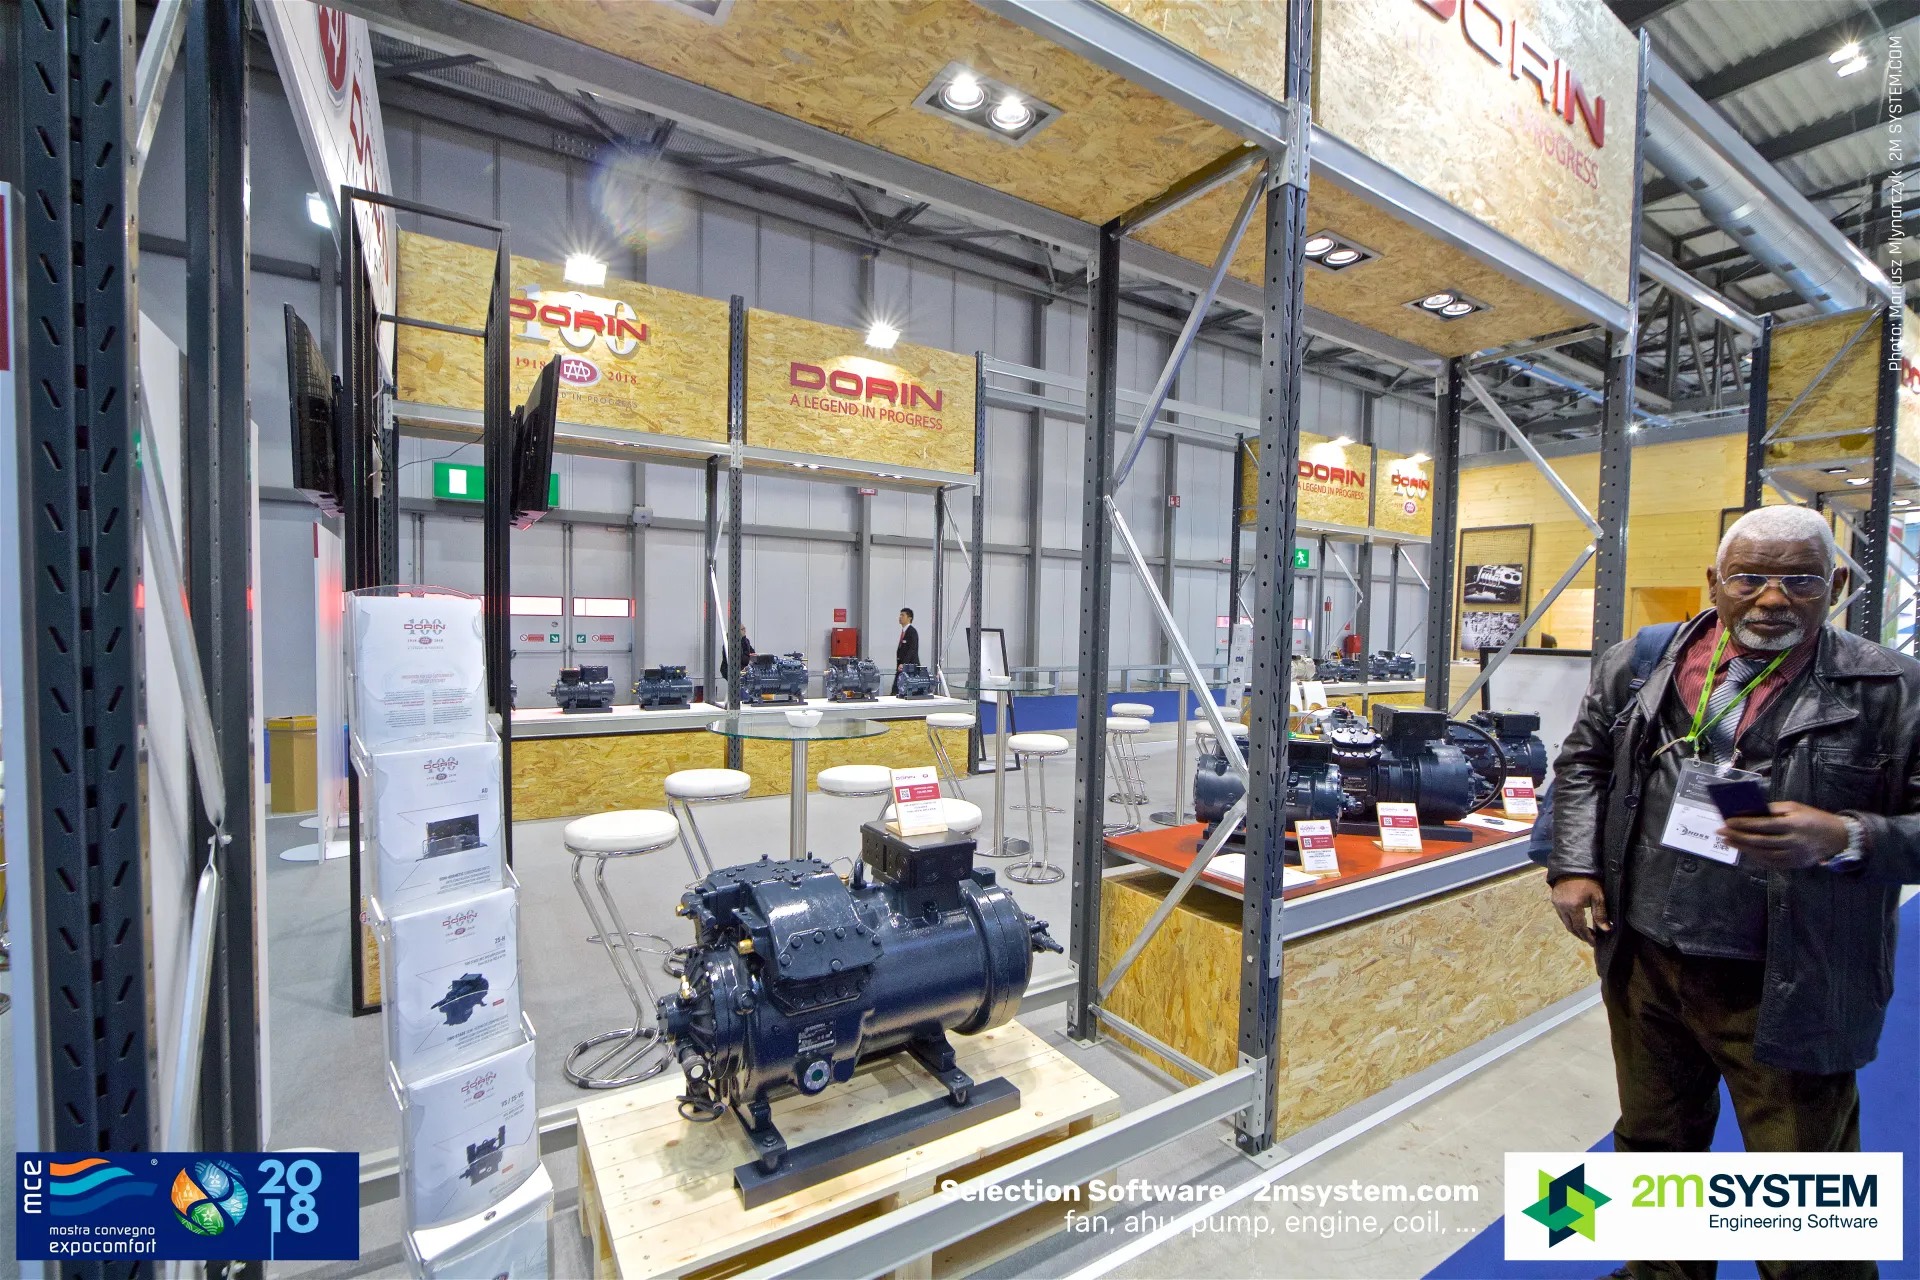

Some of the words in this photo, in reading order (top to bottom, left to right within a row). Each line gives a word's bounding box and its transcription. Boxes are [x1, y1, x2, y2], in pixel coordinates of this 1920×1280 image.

[1412, 0, 1606, 149] ORIN
[515, 356, 546, 370] 1918
[607, 371, 638, 385] 2018
[789, 361, 943, 412] DORIN
[789, 393, 800, 407] A
[804, 395, 859, 416] LEGEND
[862, 405, 876, 420] IN
[879, 408, 943, 431] PROGRESS
[1298, 460, 1366, 488] DORIN
[1302, 482, 1327, 494] LEGEND
[1335, 488, 1365, 500] PROGRESS
